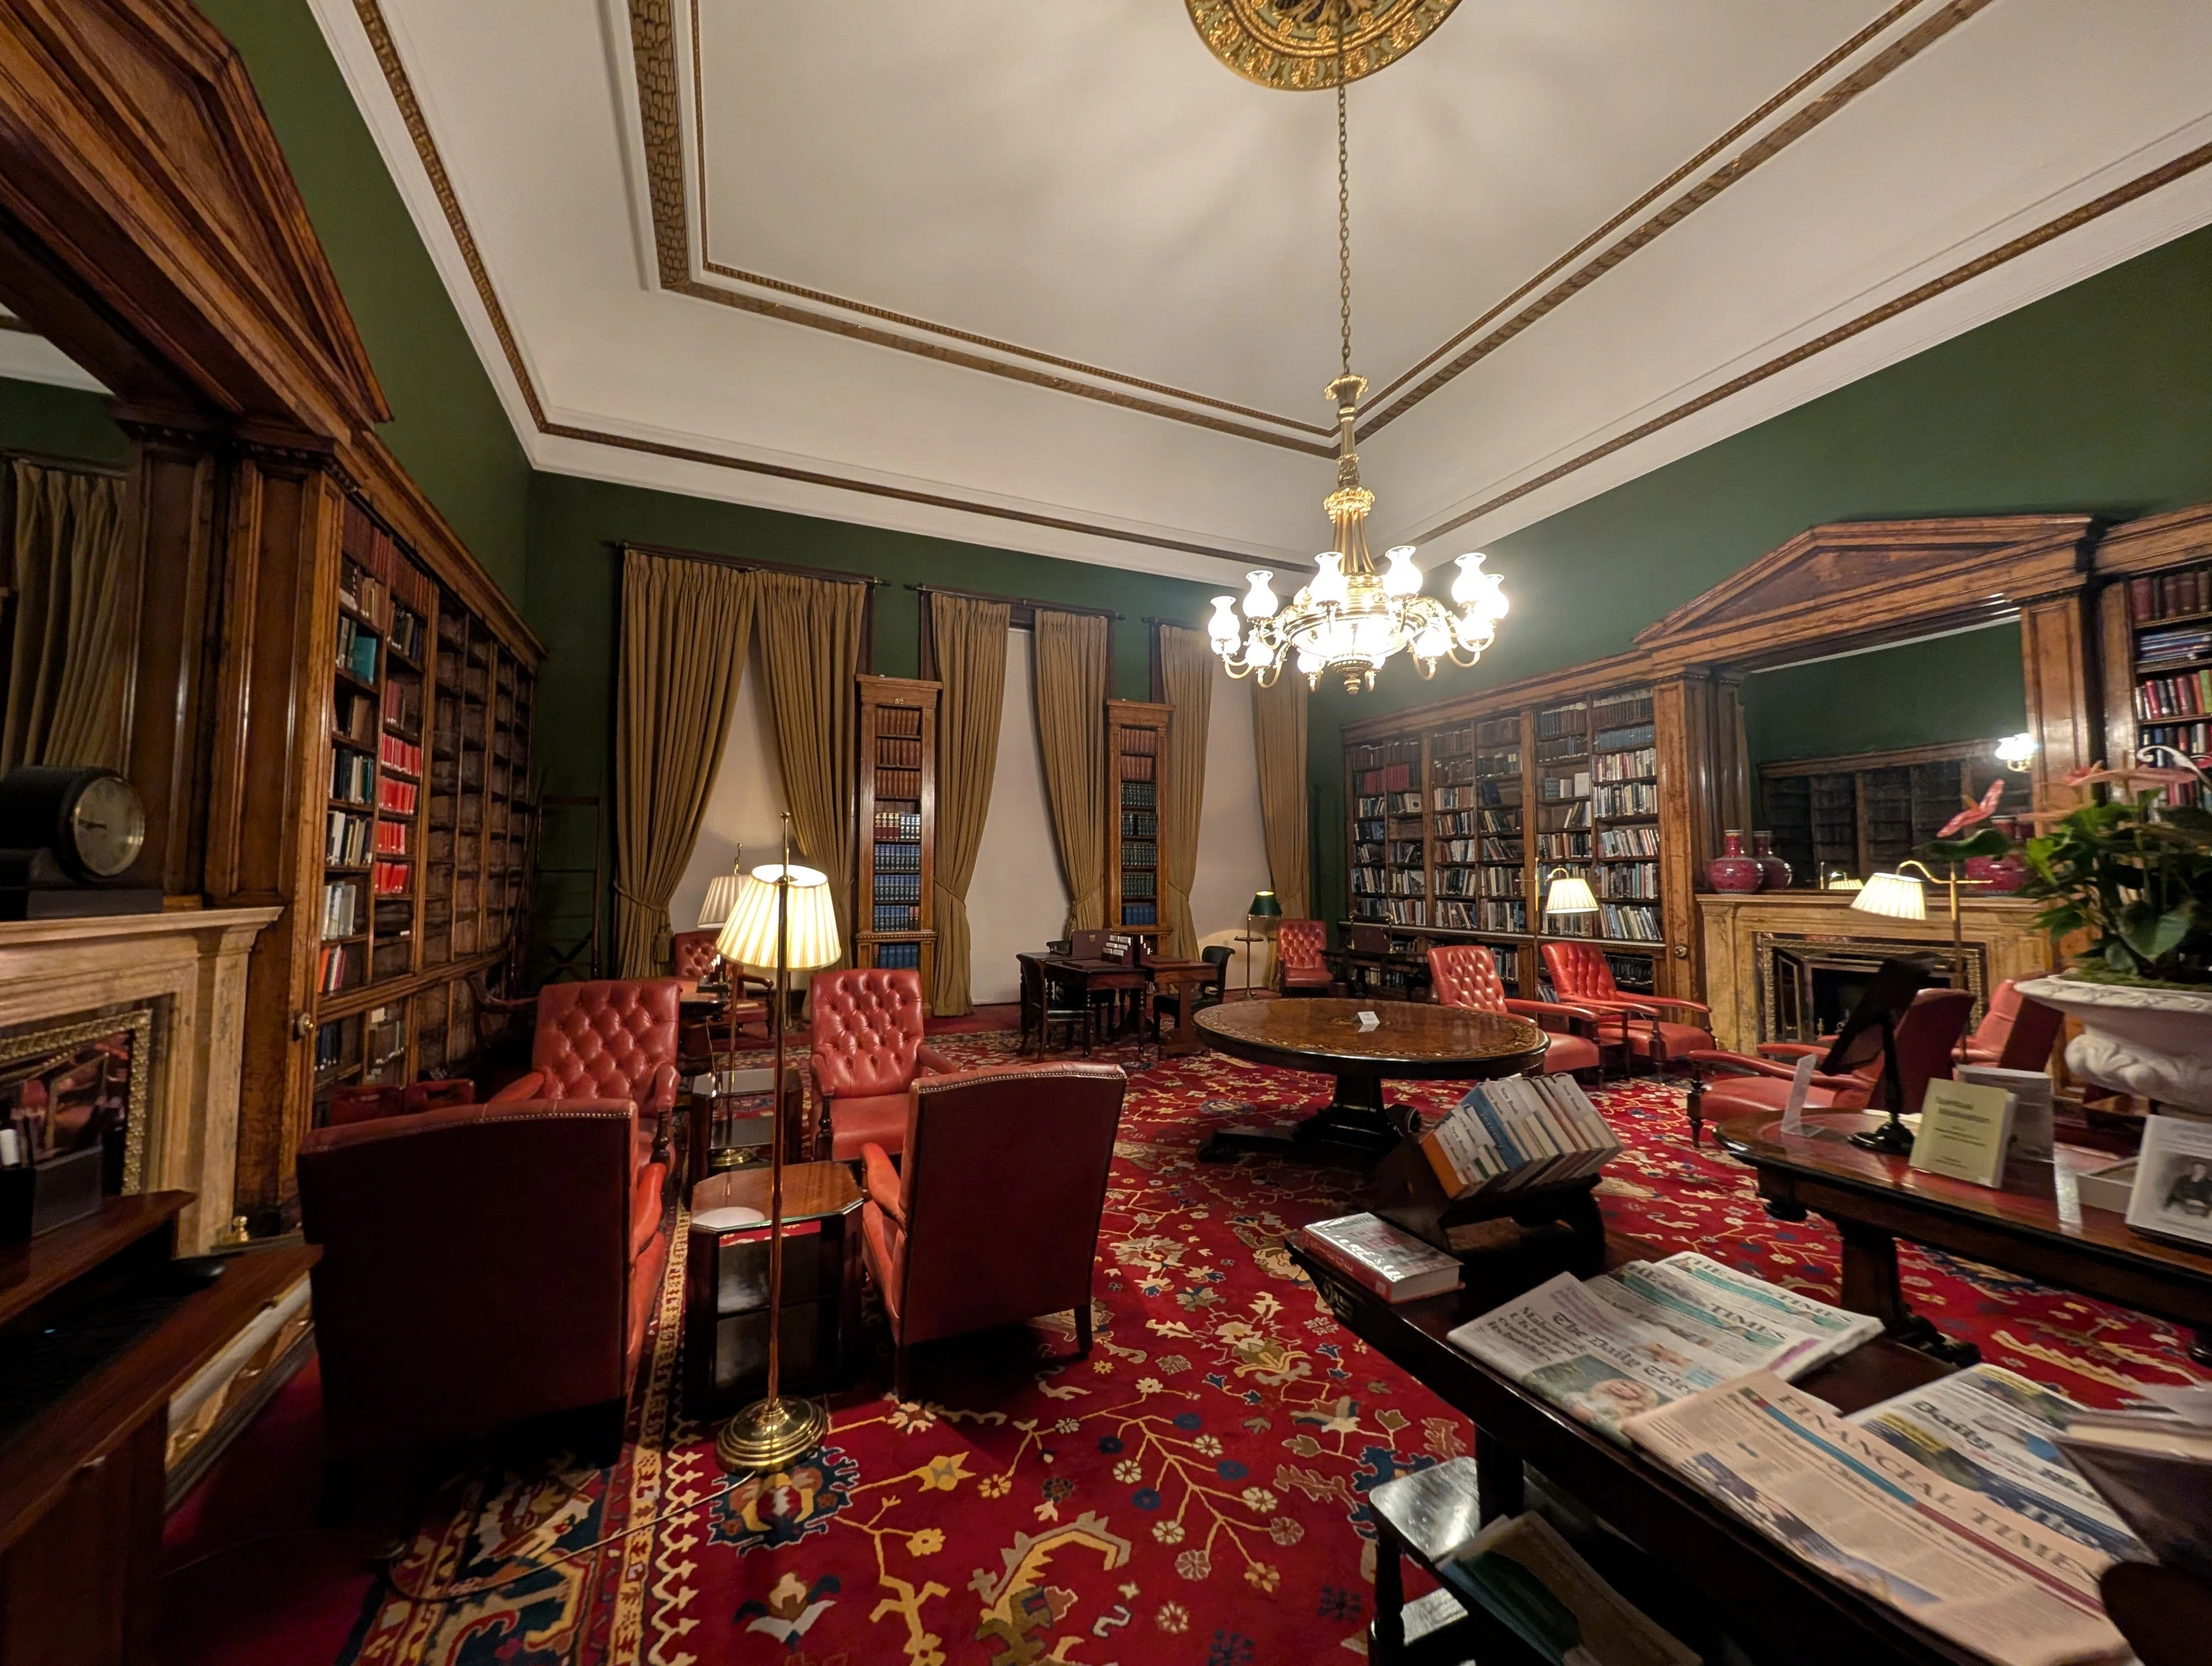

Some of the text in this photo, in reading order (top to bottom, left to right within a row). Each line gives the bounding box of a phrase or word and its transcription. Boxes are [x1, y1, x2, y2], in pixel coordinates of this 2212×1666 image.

[1710, 1303, 1786, 1340] TIMES
[1777, 1292, 1852, 1322] TIMES
[1553, 1311, 1588, 1337] The
[1586, 1336, 1641, 1368] Daily
[1912, 1400, 1995, 1451] Daily
[1777, 1394, 1957, 1510] FINANCIAL
[1971, 1507, 2100, 1584] TIMES
